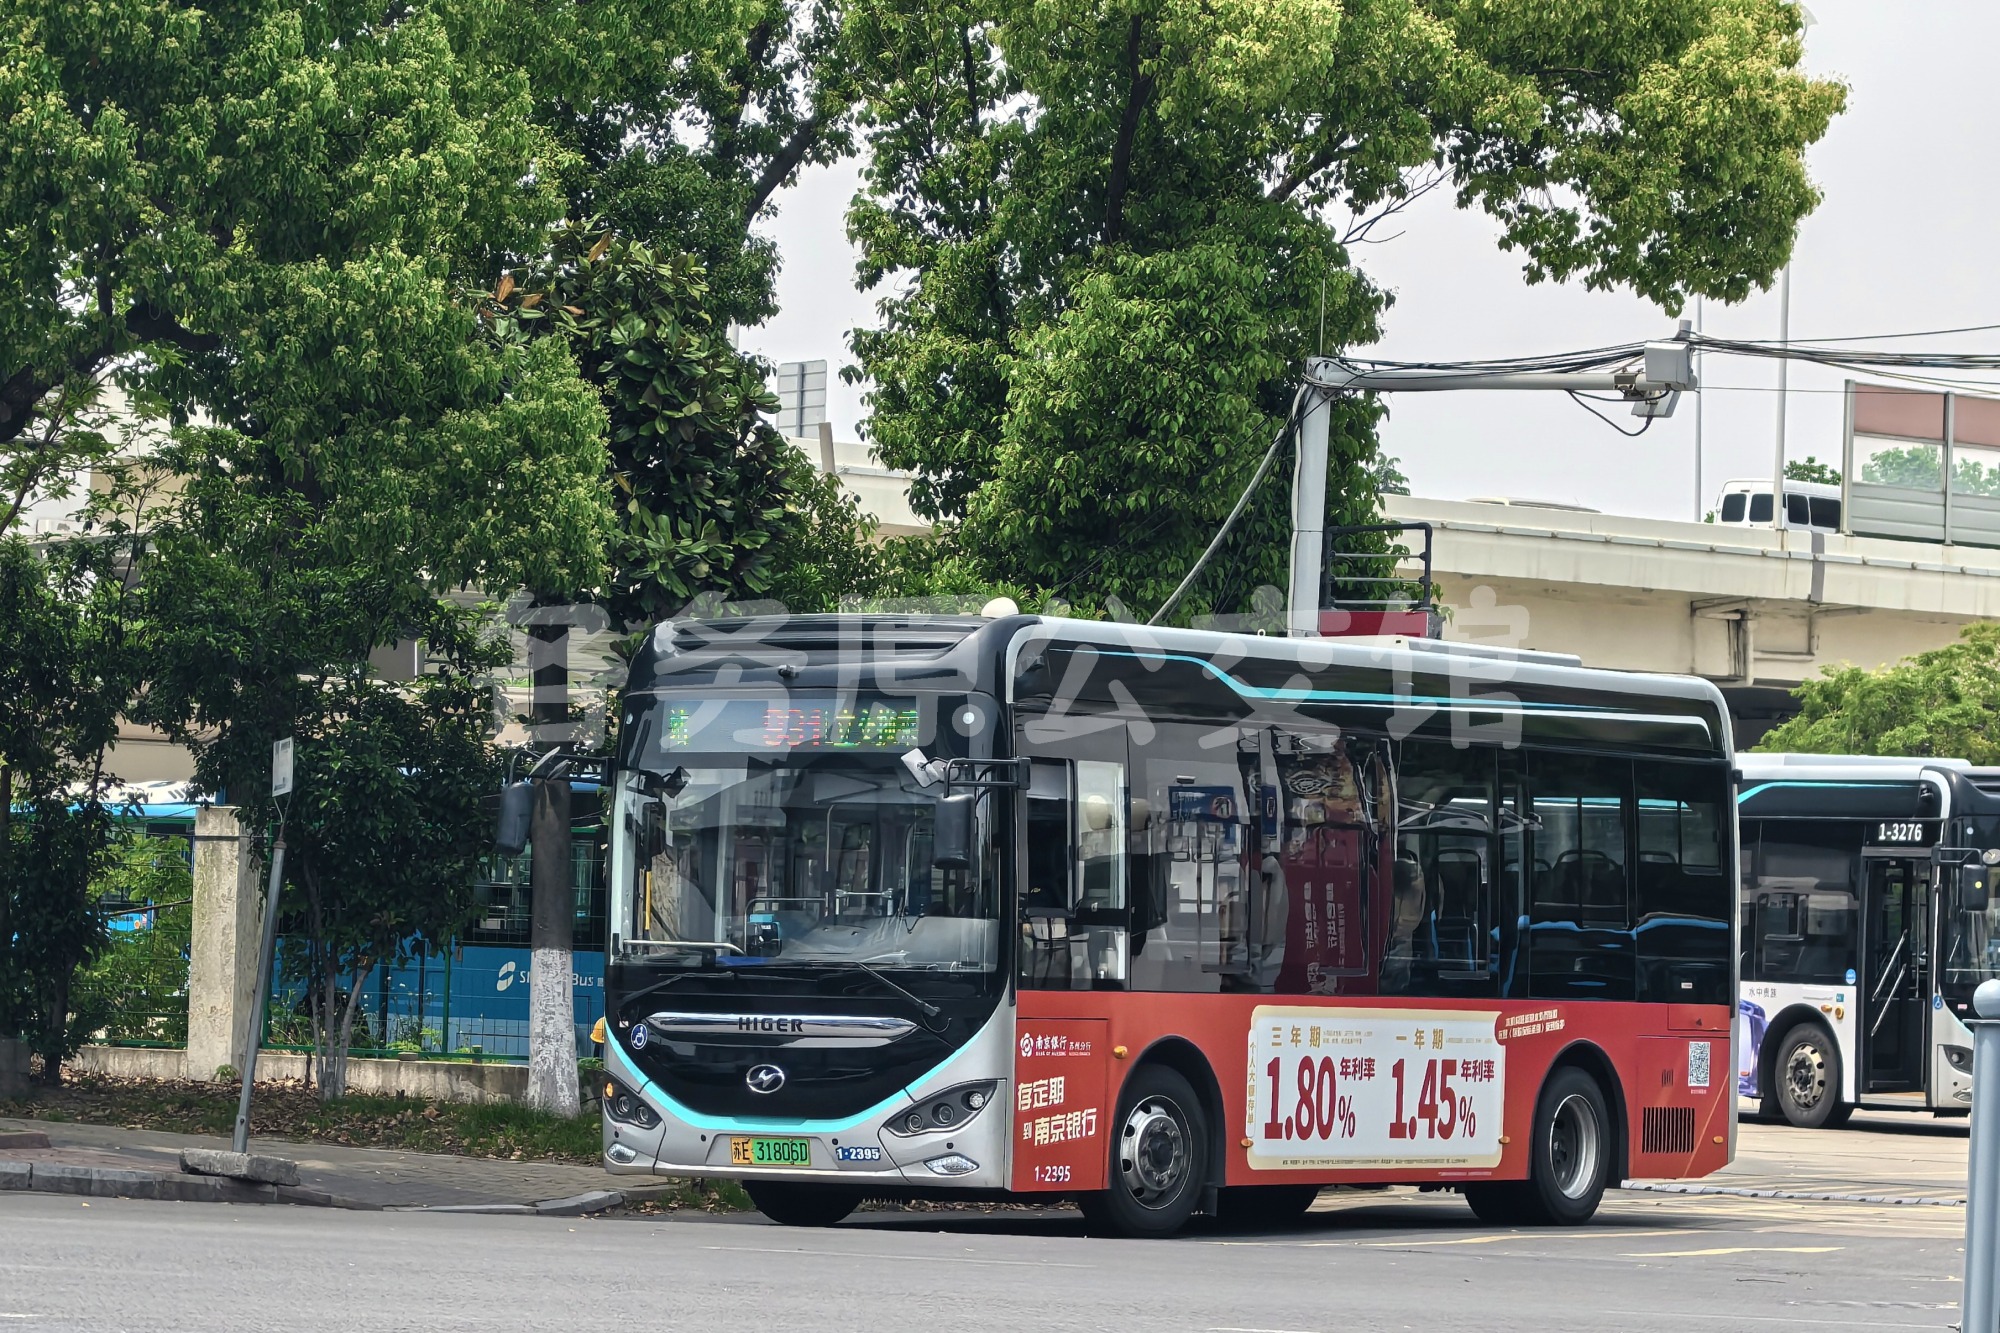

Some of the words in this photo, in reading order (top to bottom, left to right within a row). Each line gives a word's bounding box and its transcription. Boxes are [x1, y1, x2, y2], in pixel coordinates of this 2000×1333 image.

[1878, 822, 1923, 841] 1-3276
[738, 1016, 803, 1033] HIGER
[1035, 1034, 1067, 1050] 南京银行
[1271, 1026, 1321, 1048] 三年期
[1395, 1028, 1444, 1050] 一年期
[1339, 1056, 1376, 1081] 年利率
[1460, 1058, 1495, 1083] 年利率
[1017, 1076, 1065, 1111] 存定期
[1034, 1165, 1071, 1182] 1-2395
